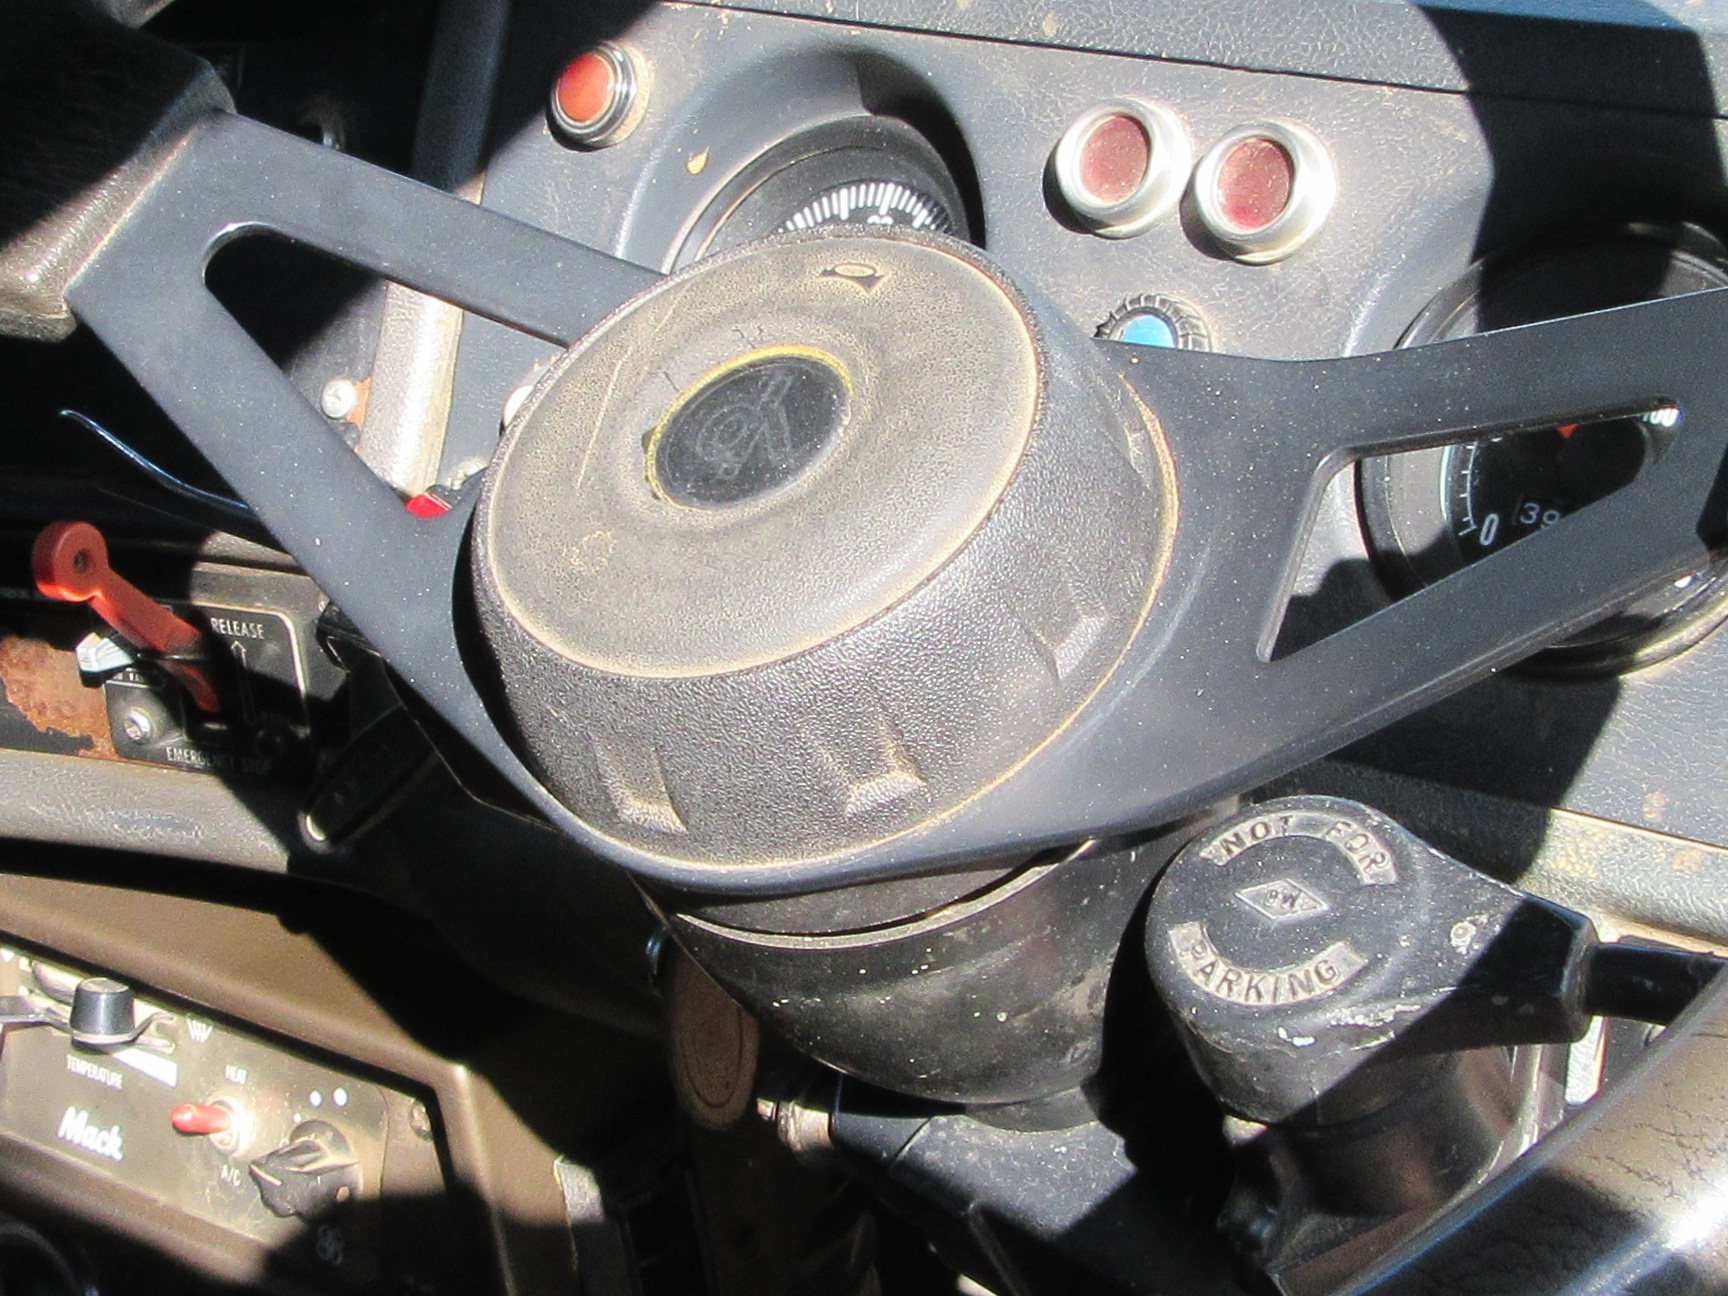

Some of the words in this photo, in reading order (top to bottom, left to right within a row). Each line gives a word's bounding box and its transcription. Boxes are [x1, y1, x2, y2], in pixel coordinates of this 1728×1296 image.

[1479, 513, 1501, 546] 0
[208, 617, 265, 648] RELEASE
[1219, 815, 1294, 858] NOT
[1325, 818, 1388, 874] FOR
[1178, 939, 1339, 1003] PARKING
[66, 1054, 123, 1091] TEMPERATURE
[224, 1063, 248, 1086] HEAT
[57, 1105, 124, 1163] Mack
[221, 1163, 242, 1187] A/C
